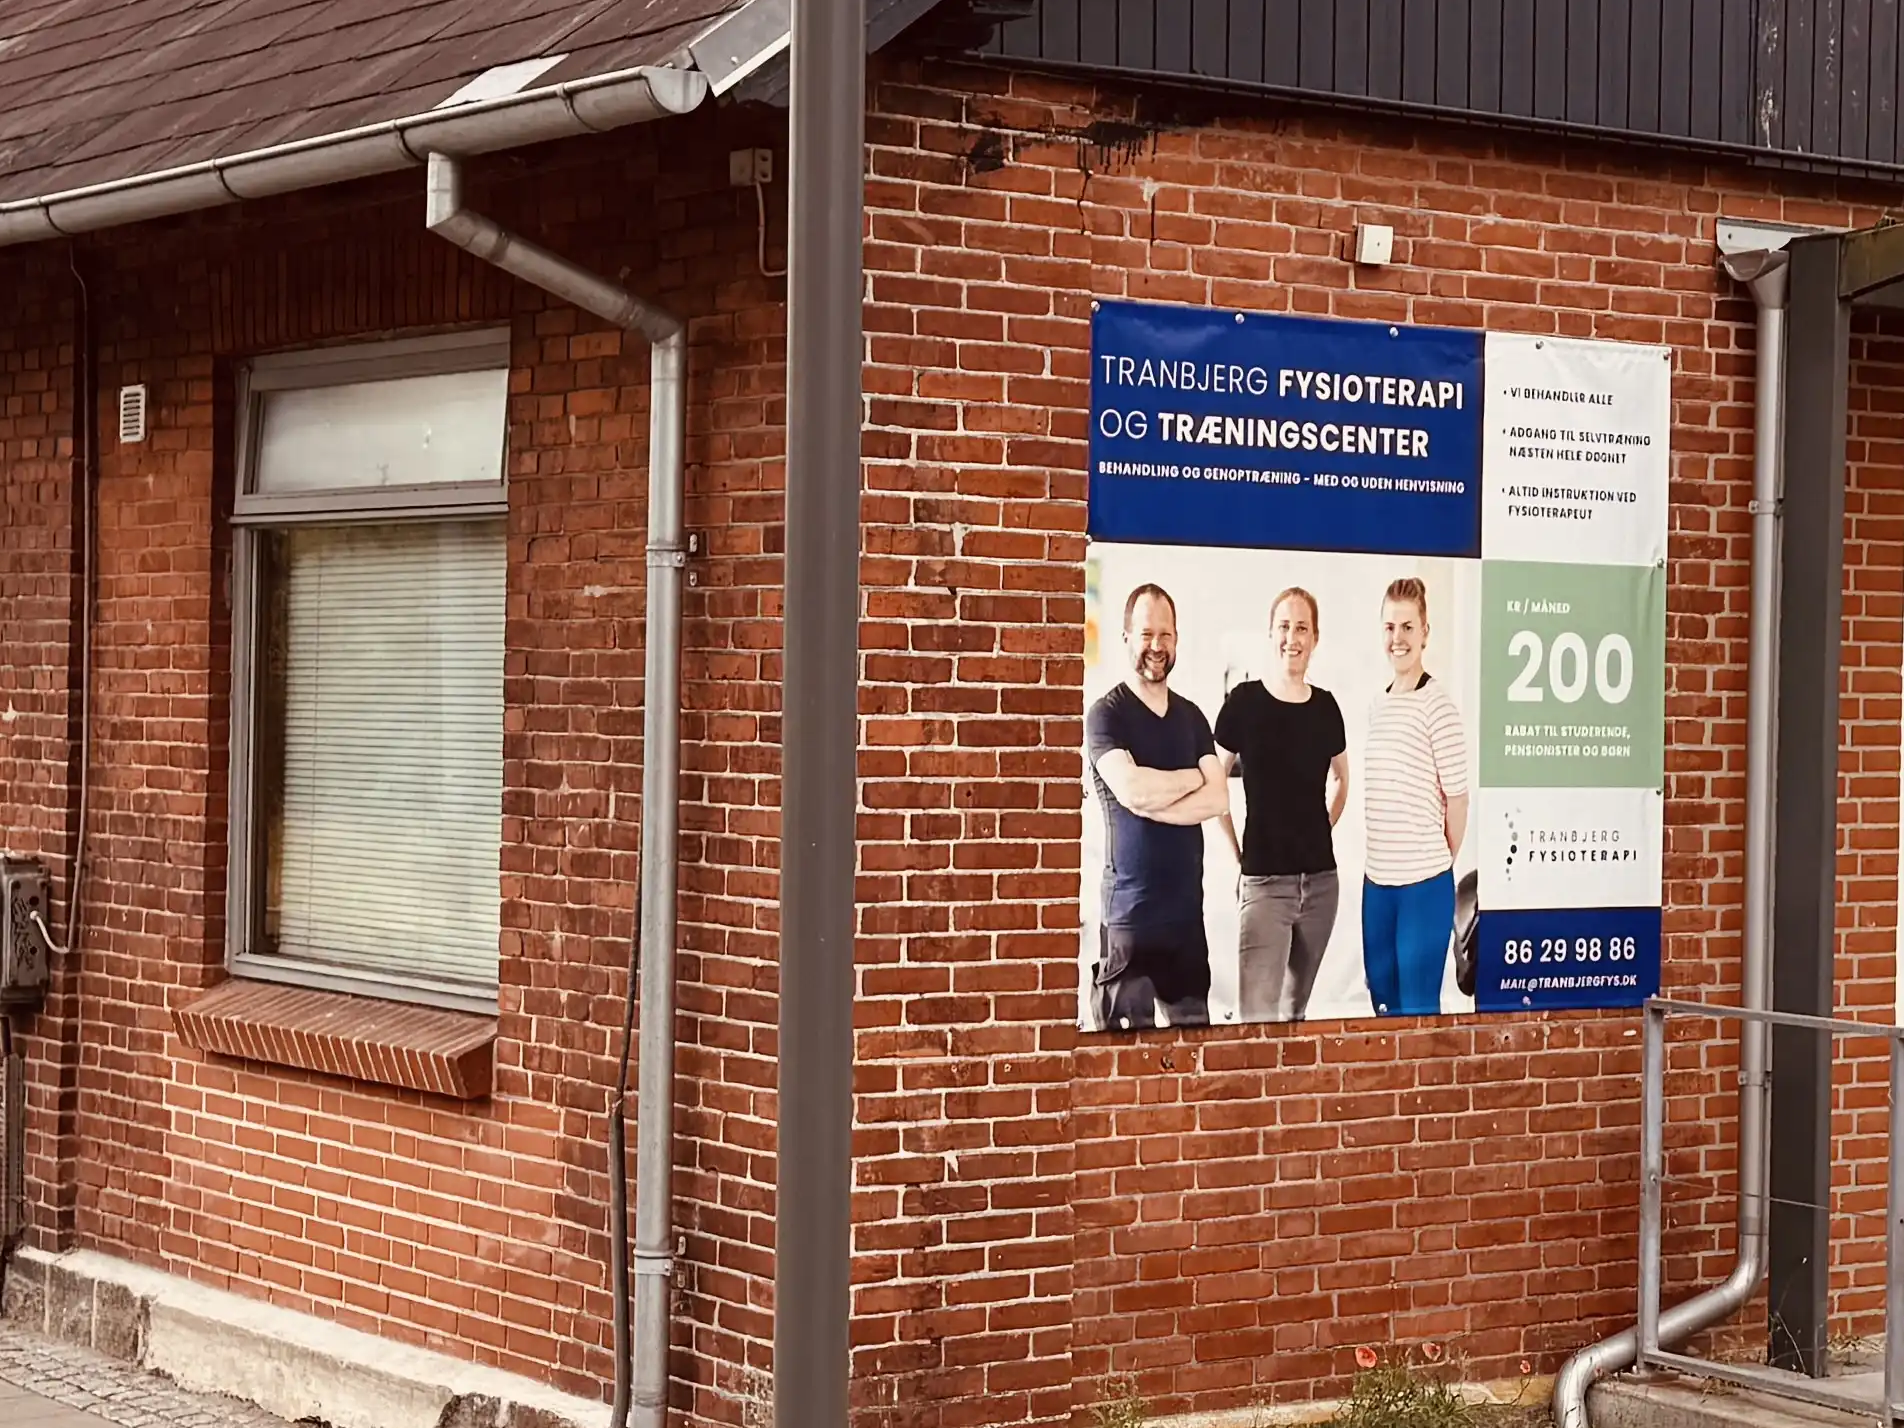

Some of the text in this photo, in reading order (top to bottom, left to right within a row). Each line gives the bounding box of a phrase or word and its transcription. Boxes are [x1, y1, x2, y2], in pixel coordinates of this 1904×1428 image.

[1100, 355, 1463, 409] TRANBJERG FYSIOTERAPI
[1510, 387, 1614, 406] VI BEHANDLER ALLE
[1099, 409, 1429, 457] OG TRÆNINGSCENTER
[1560, 430, 1575, 441] TIL
[1509, 446, 1553, 459] NÆSTEN
[1556, 449, 1583, 462] HELE
[1099, 461, 1179, 477] BEHANDLING
[1182, 466, 1200, 479] OG
[1204, 468, 1300, 484] GENOPTRÆNING
[1314, 474, 1338, 487] MED
[1341, 476, 1358, 488] OG
[1361, 477, 1393, 490] UDEN
[1395, 479, 1465, 494] HENVISNING
[1509, 485, 1637, 503] ALTID INSTRUKTION VED
[1508, 505, 1593, 520] FYSIOTERAPEUT
[1507, 600, 1521, 612] KR
[1531, 598, 1570, 614] MÅNED
[1507, 630, 1634, 704] 200
[1505, 725, 1540, 737] RABAT
[1544, 725, 1559, 737] TIL
[1505, 744, 1580, 756] PENSIONISTER
[1583, 745, 1598, 756] OG
[1529, 830, 1620, 842] TRANBJERG
[1529, 850, 1637, 862] FYSIOTERAPI
[1504, 936, 1636, 964] 86 29 98 86
